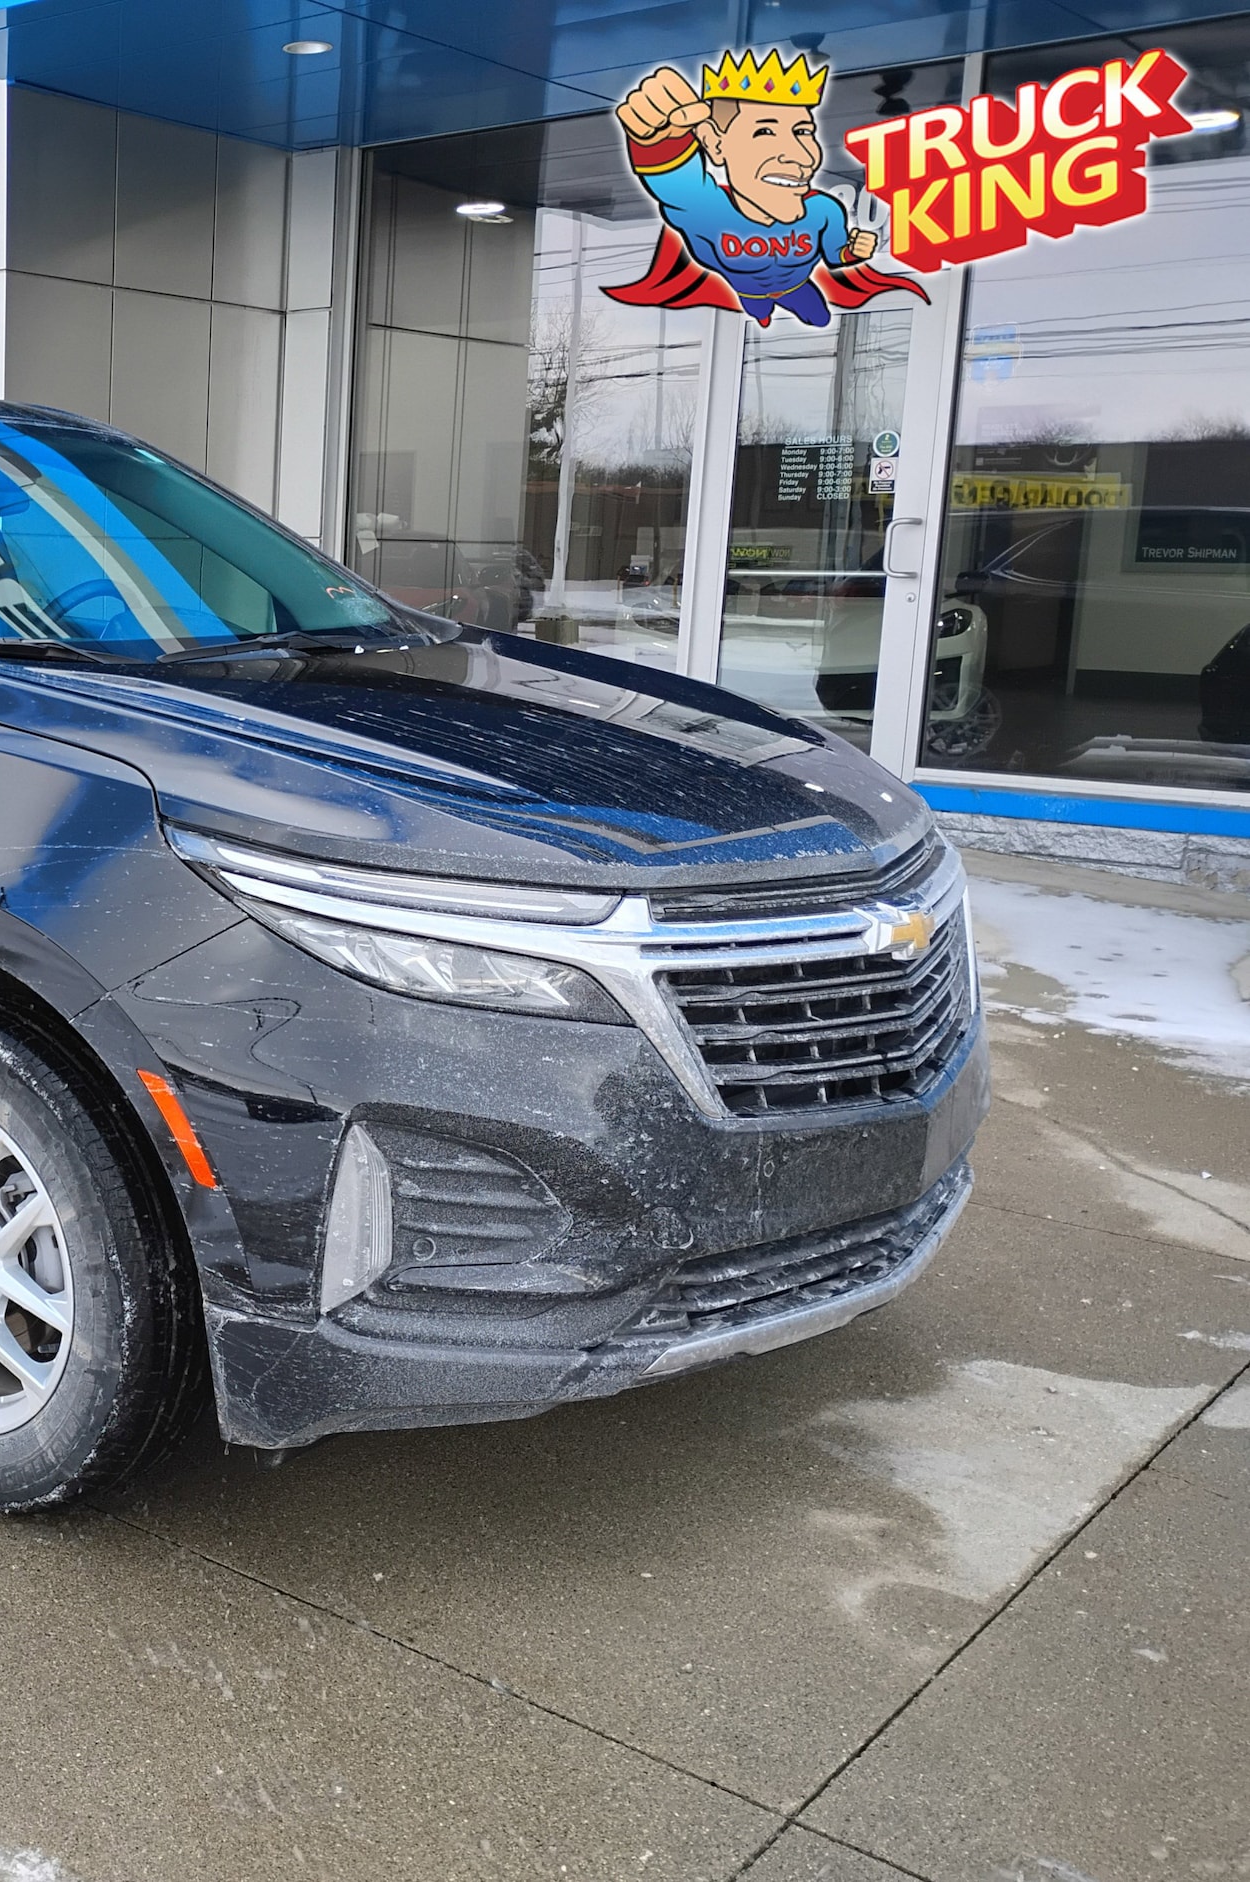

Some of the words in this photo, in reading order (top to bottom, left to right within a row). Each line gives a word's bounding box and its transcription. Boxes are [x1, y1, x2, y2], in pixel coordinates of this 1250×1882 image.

[818, 435, 852, 444] HOURS
[820, 447, 854, 455] 9:00-7:00
[819, 455, 854, 463] 9:00-6:00
[818, 470, 853, 478] 9:00-7:00
[779, 479, 799, 487] Friday
[817, 478, 852, 486] 9:00-6:00
[778, 494, 801, 502] Sunday
[1142, 546, 1184, 558] TREVOR
[1187, 546, 1237, 558] SHIPMAN
